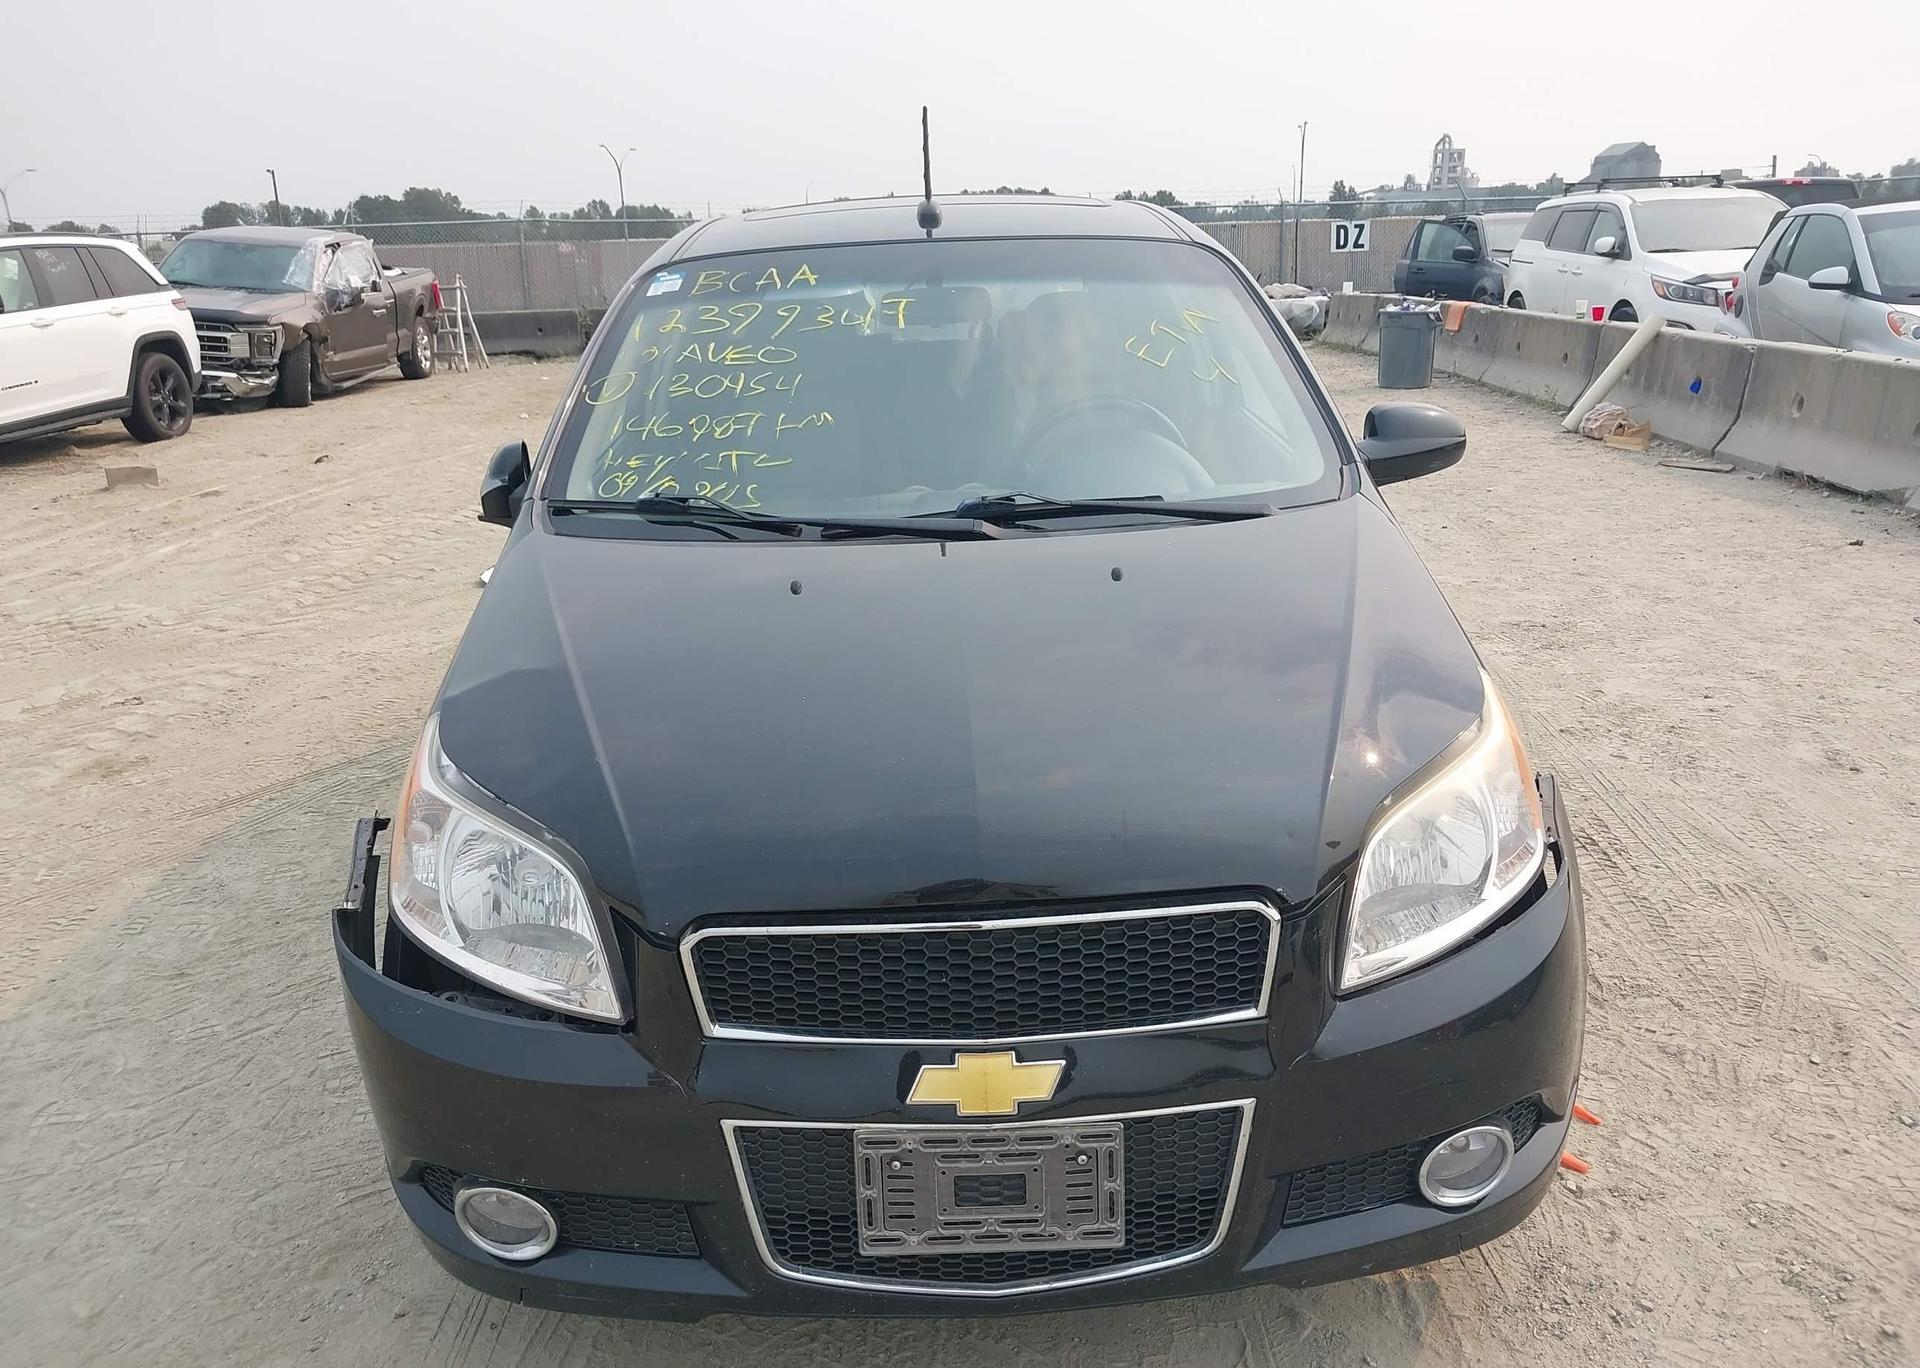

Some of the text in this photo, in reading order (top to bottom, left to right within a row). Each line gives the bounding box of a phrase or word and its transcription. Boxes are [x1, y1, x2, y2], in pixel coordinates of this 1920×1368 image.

[1335, 223, 1365, 250] DZ
[688, 264, 819, 297] BCAA
[676, 341, 798, 365] AVEO
